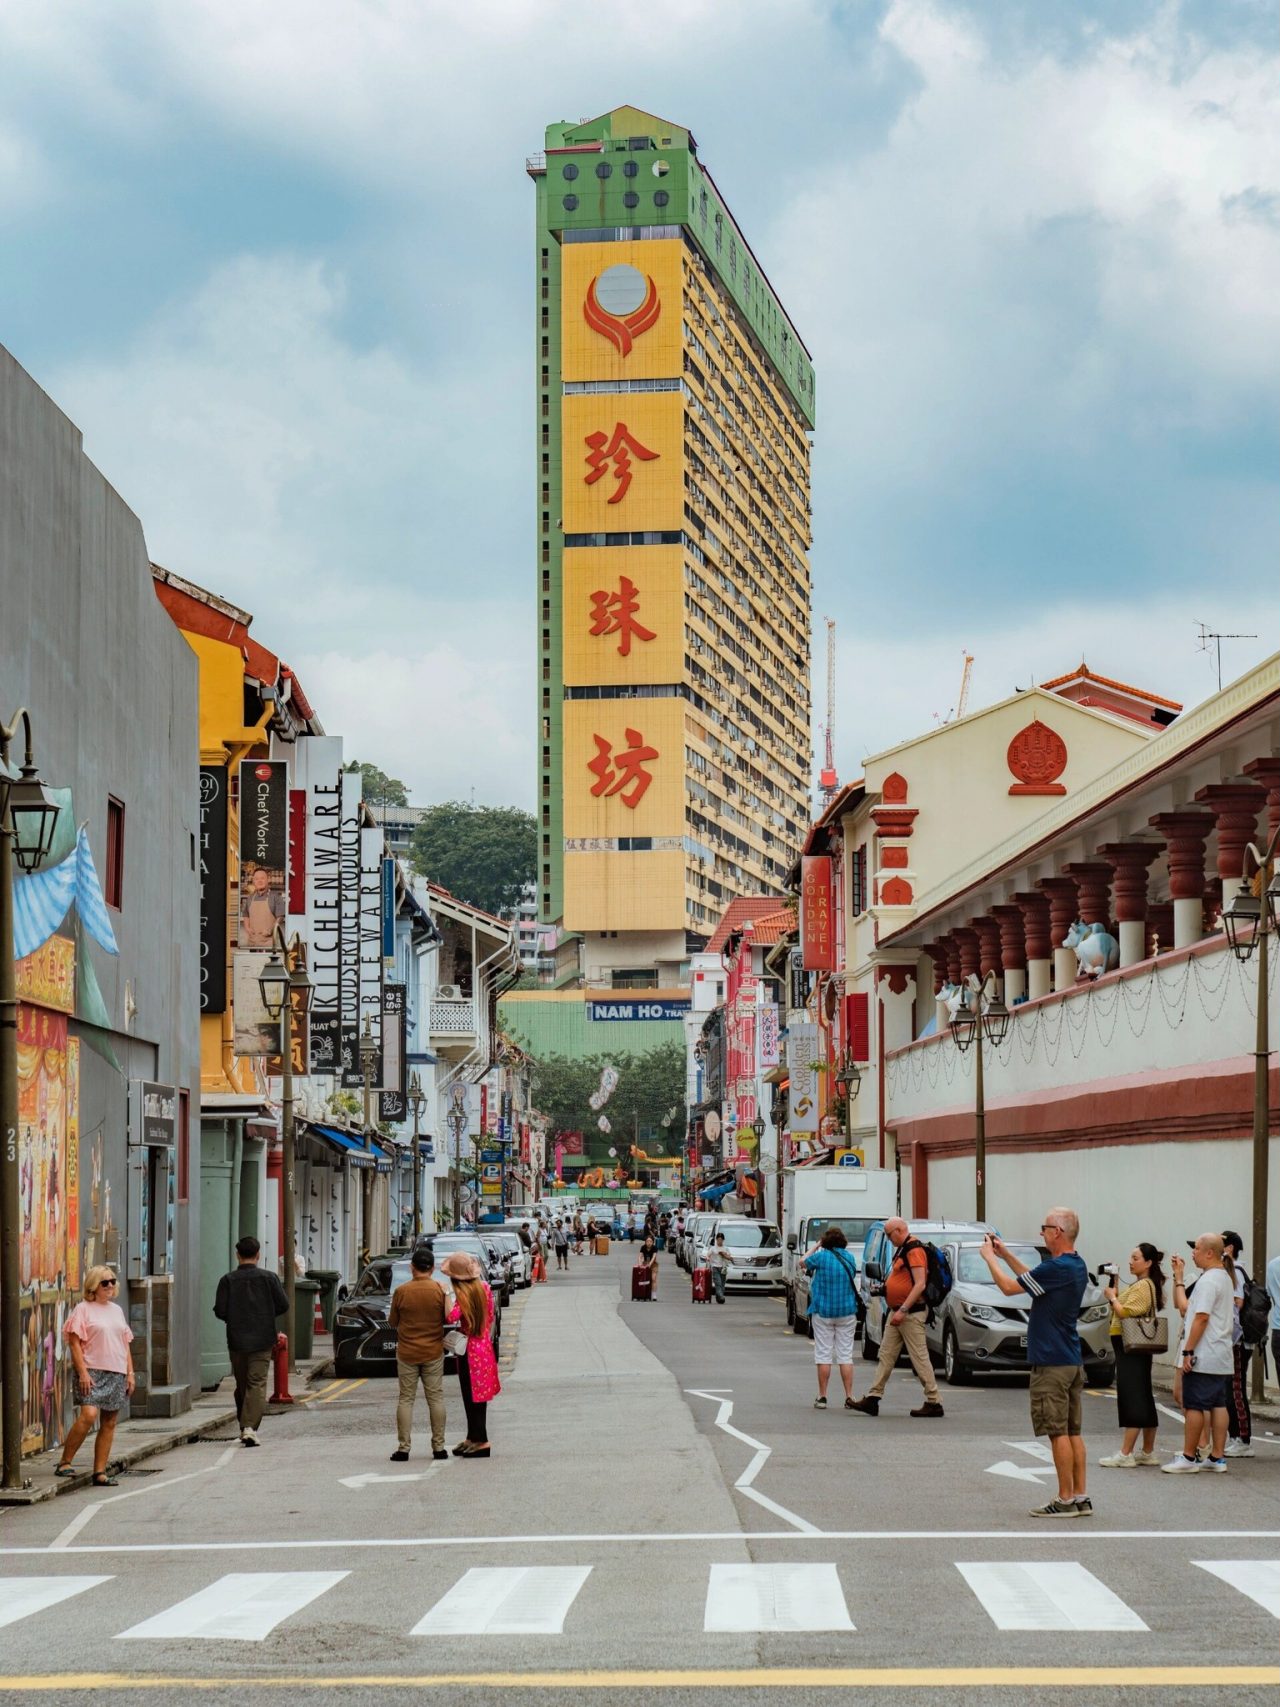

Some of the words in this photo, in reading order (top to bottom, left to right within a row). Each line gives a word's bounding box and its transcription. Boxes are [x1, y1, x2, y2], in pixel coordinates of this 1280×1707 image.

[584, 421, 661, 809] 珍珠坊
[314, 784, 340, 1008] KITCHENWARE
[806, 873, 816, 943] GOLDEN
[818, 885, 828, 955] TRAVEL
[595, 1005, 633, 1019] NAM
[638, 1005, 663, 1018] HO
[794, 1043, 804, 1091] Golden
[802, 1042, 812, 1096] Compass
[7, 1128, 16, 1162] 23
[287, 1171, 294, 1191] 21
